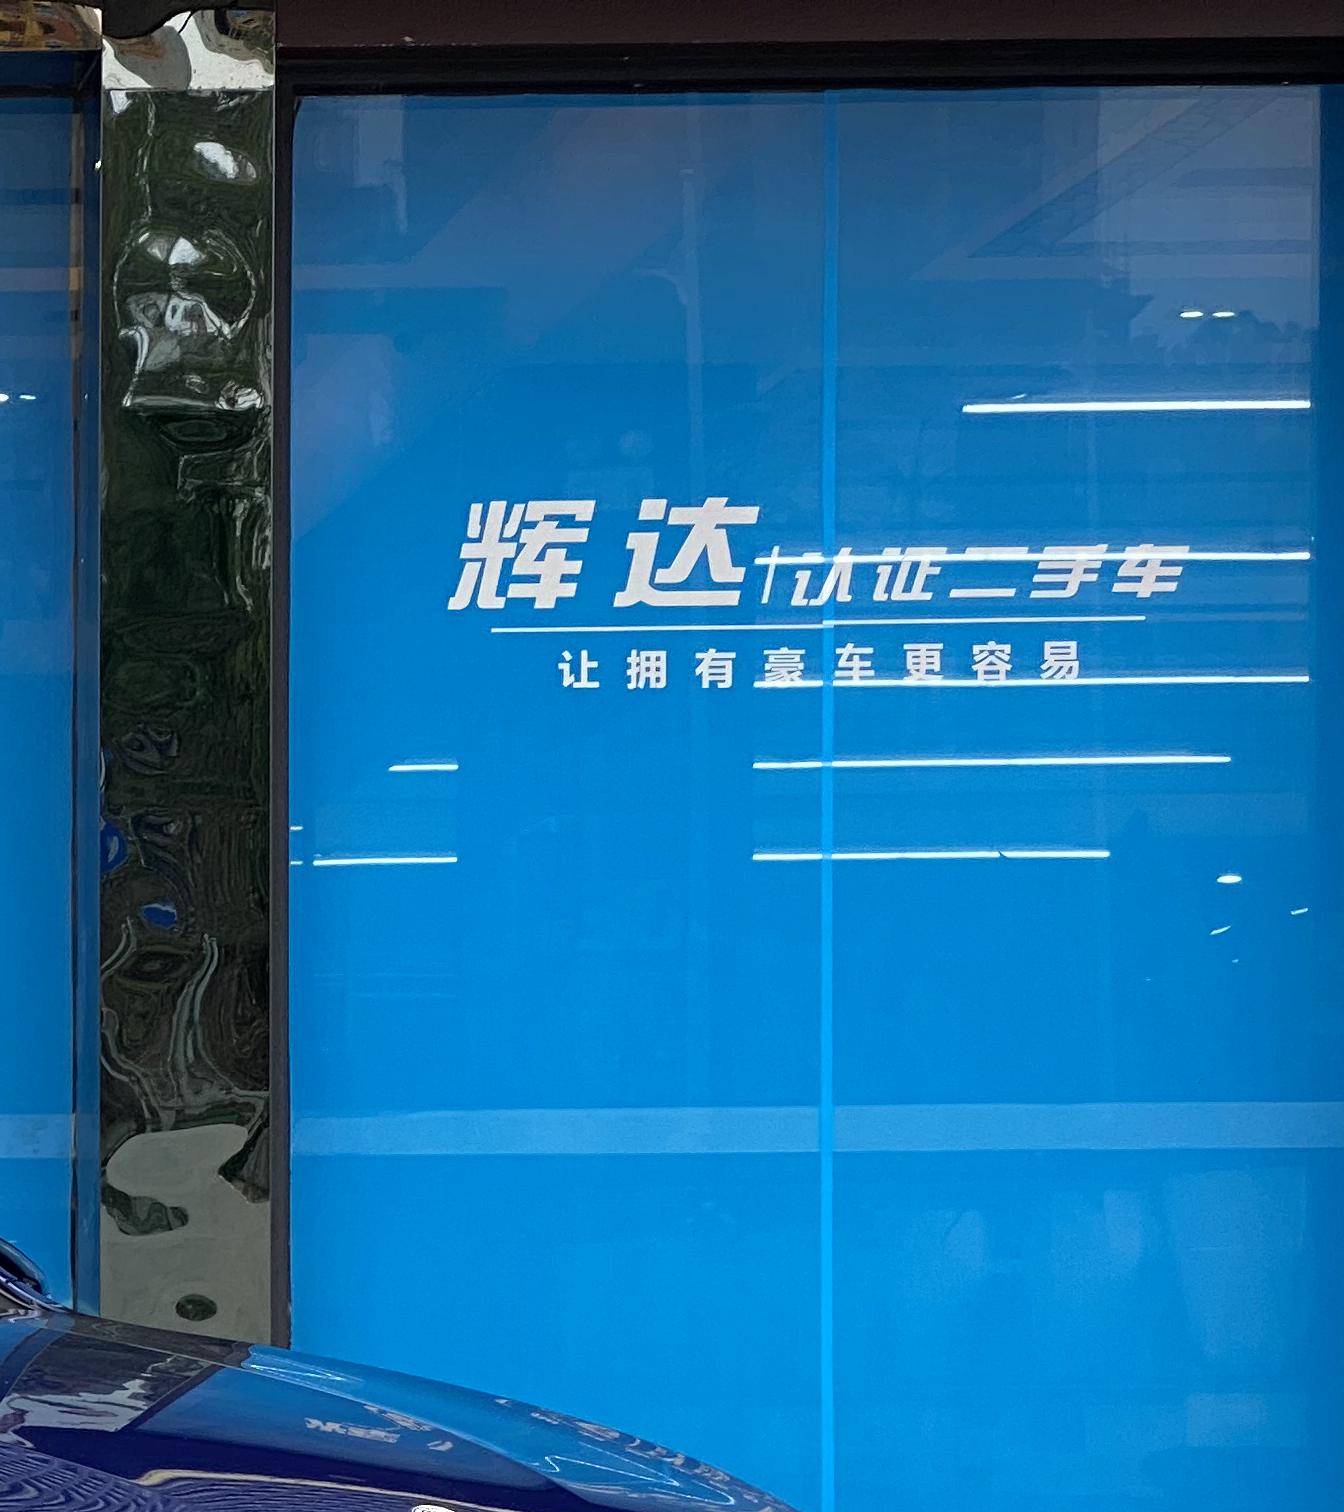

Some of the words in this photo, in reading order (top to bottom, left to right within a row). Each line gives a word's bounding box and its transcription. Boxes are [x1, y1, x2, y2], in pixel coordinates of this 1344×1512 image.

[447, 496, 760, 611] 辉达
[790, 543, 1190, 607] 认证二手车
[557, 640, 1082, 690] 让拥有豪车更容易
